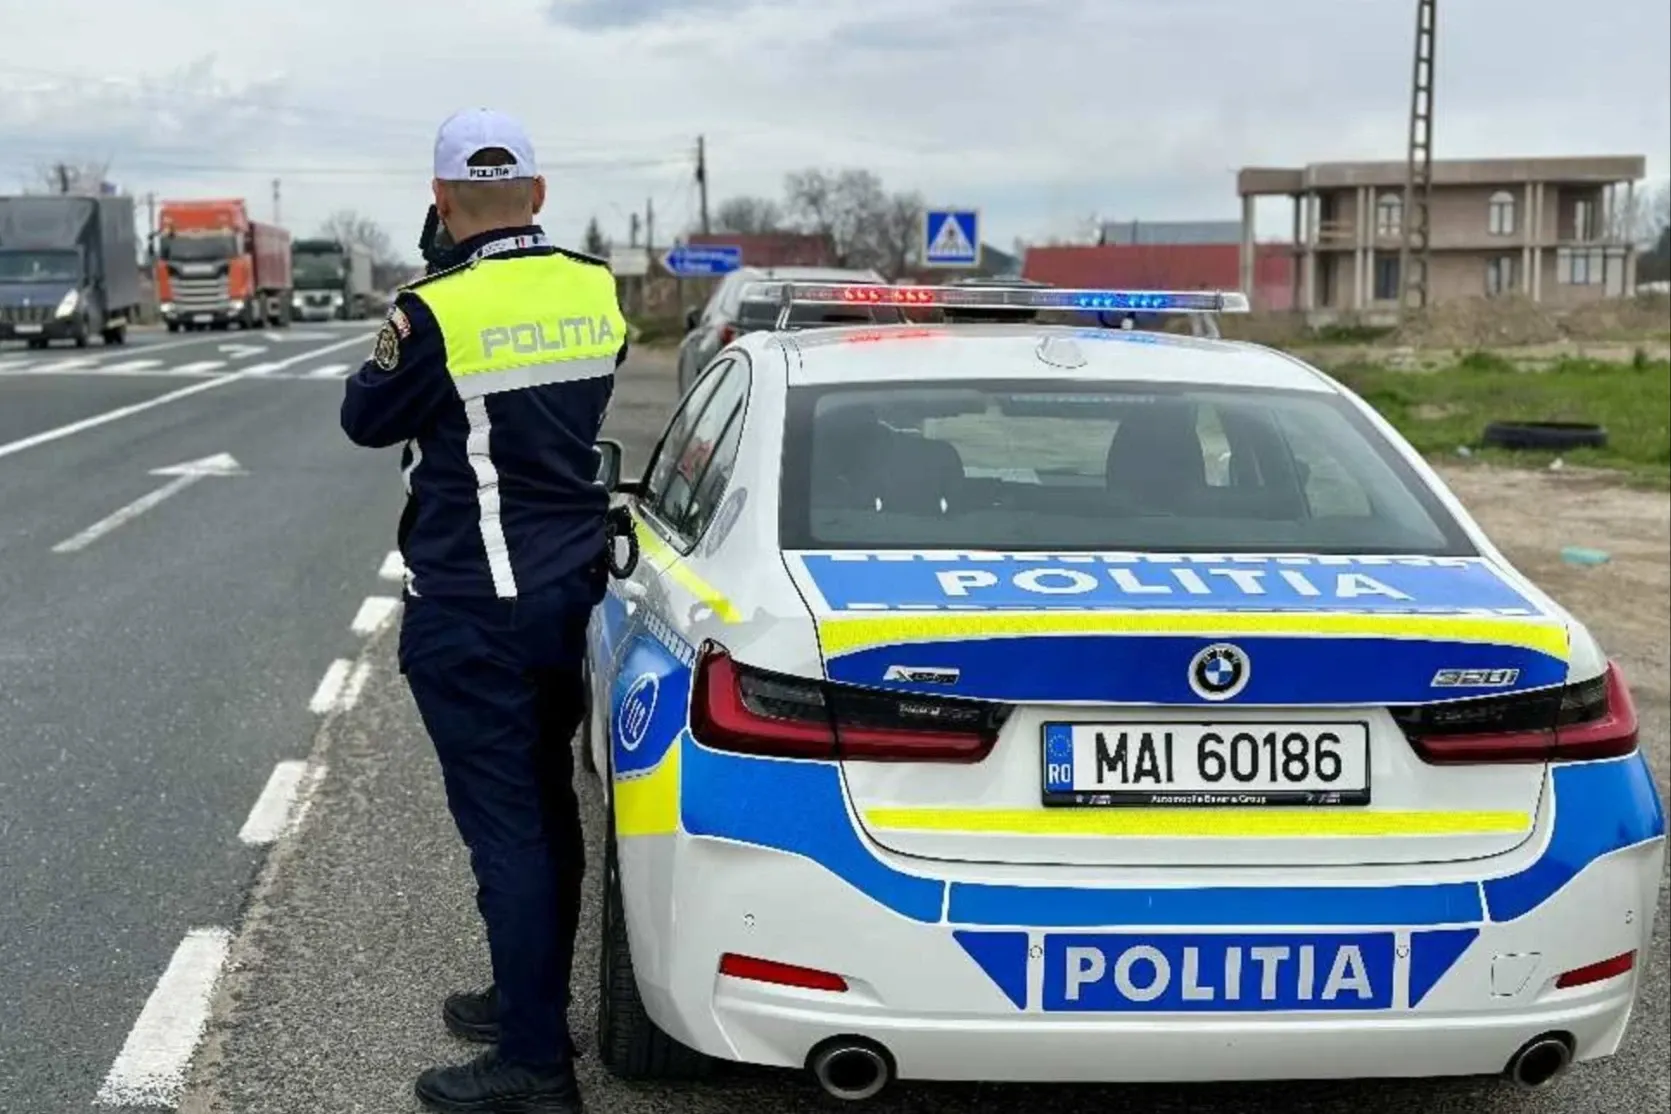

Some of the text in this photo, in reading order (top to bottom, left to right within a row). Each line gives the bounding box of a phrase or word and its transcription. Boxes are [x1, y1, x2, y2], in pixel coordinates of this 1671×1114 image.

[469, 167, 510, 178] POLITIA
[481, 314, 615, 359] POLITIA
[935, 567, 1414, 601] POLITIA
[1048, 763, 1071, 784] RO
[1095, 732, 1342, 784] MAI 60186
[1065, 945, 1373, 1001] POLITIA
